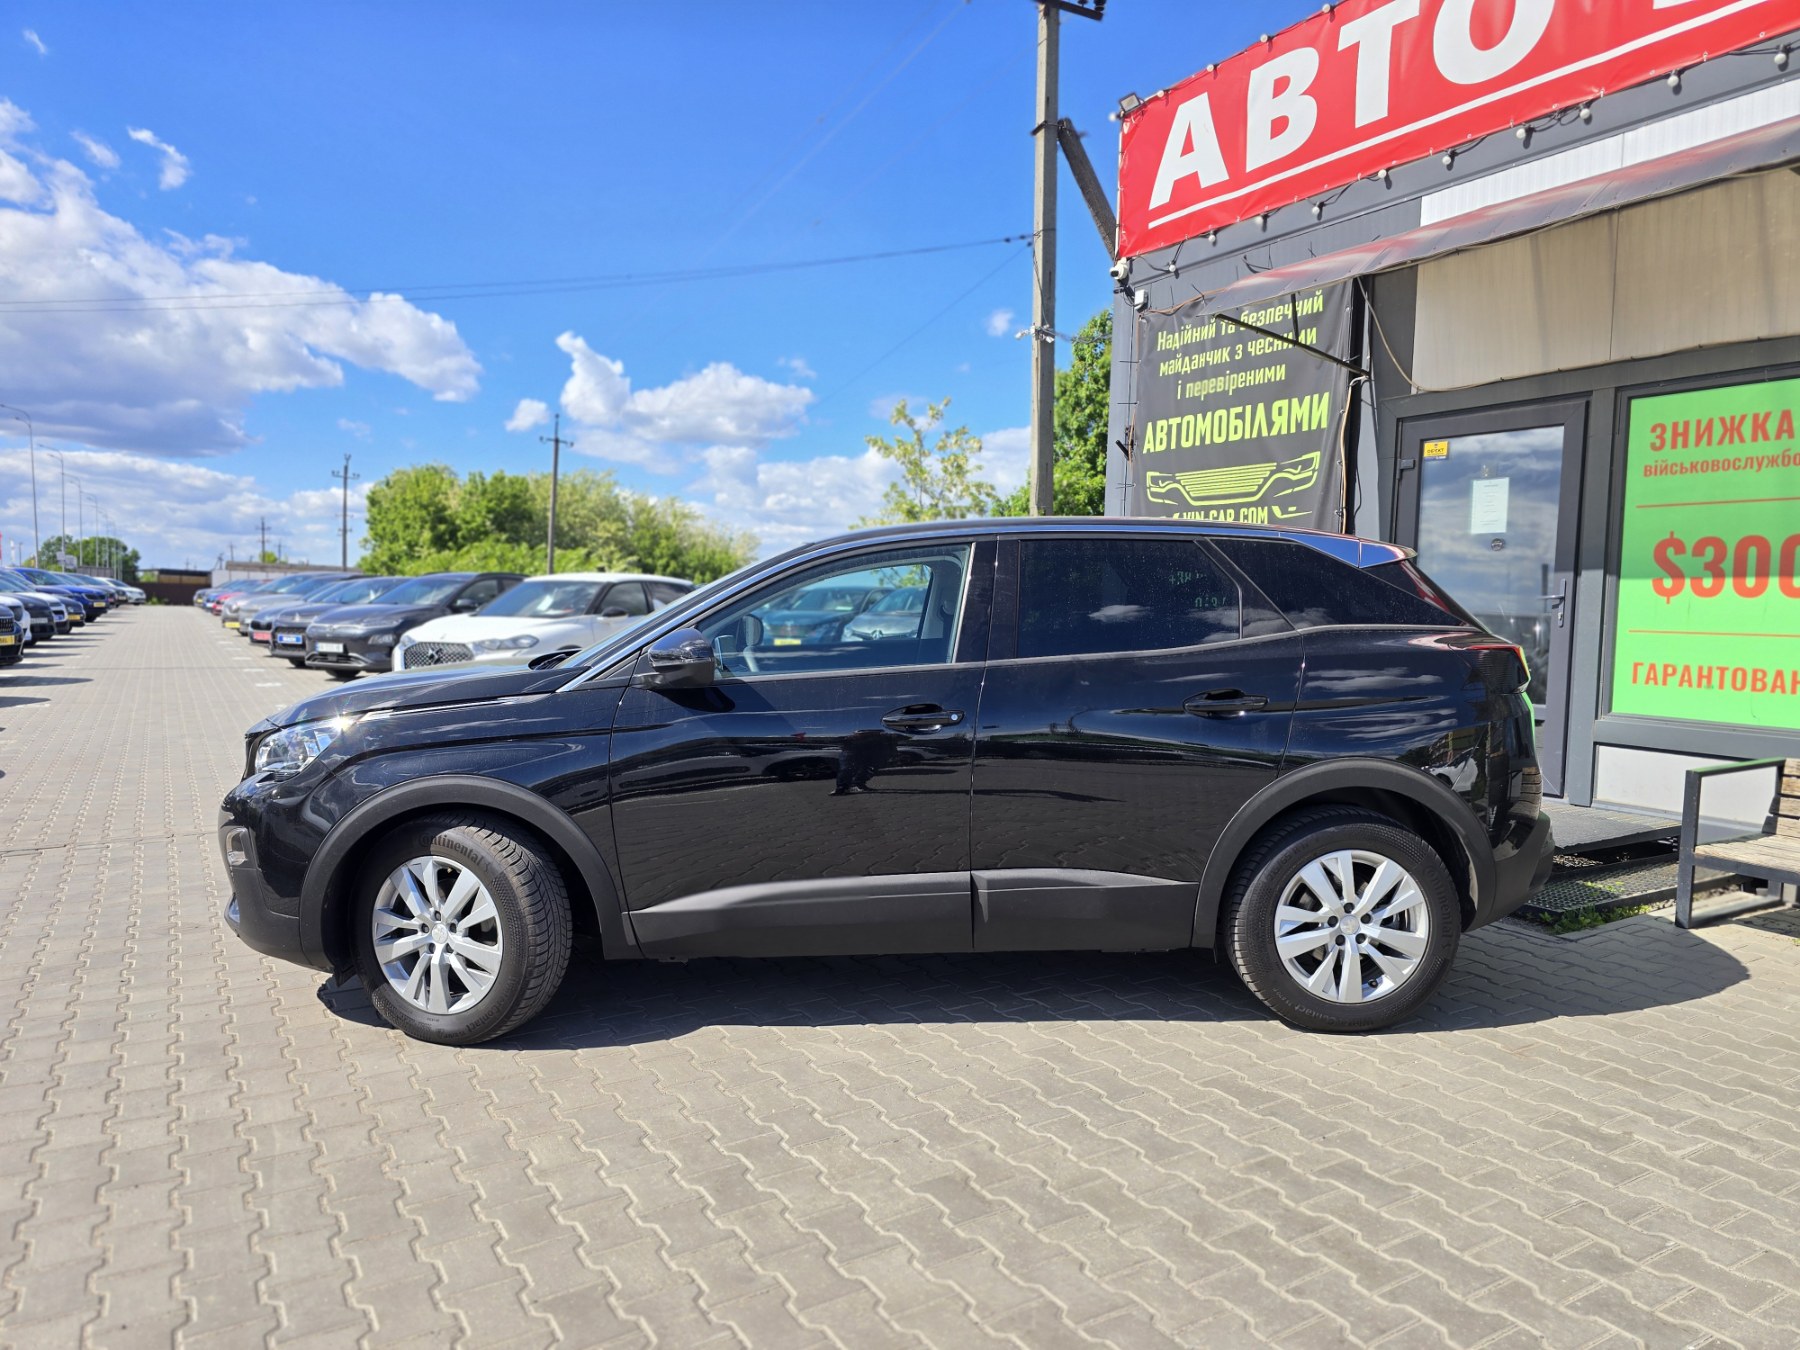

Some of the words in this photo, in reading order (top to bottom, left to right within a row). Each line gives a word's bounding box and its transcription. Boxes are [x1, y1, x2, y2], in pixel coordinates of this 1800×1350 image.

[1148, 0, 1556, 210] АВТО
[1157, 318, 1216, 351] Надійний
[1159, 346, 1231, 377] майданчик
[1235, 344, 1243, 360] з
[1177, 380, 1182, 400] і
[1185, 364, 1286, 400] перевіреними
[1142, 391, 1330, 454] АВТОМОБІЛЯМИ
[1649, 408, 1796, 452] ЗНИЖКА
